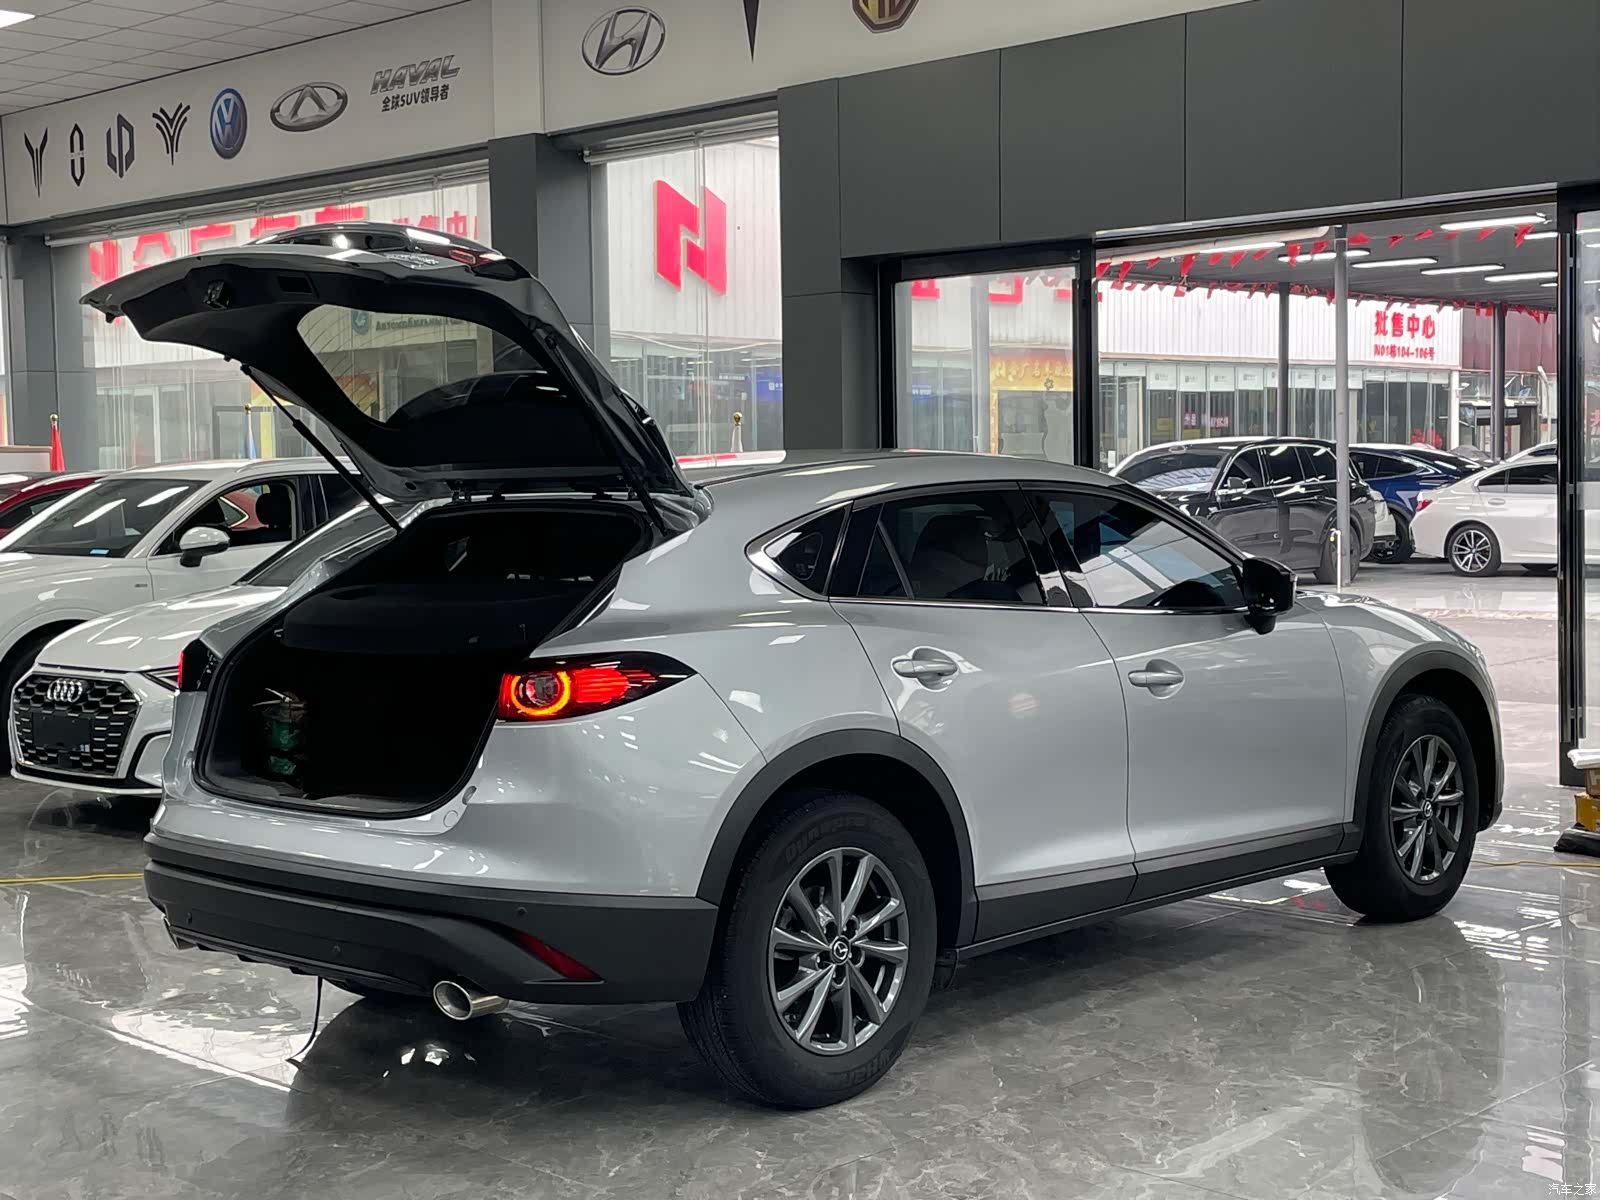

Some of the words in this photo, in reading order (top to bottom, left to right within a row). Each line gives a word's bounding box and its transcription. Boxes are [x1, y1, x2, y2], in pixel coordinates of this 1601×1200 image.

[370, 55, 461, 95] HAVAL
[381, 83, 449, 112] 全球SUV领导者
[1374, 309, 1436, 340] 批售中心
